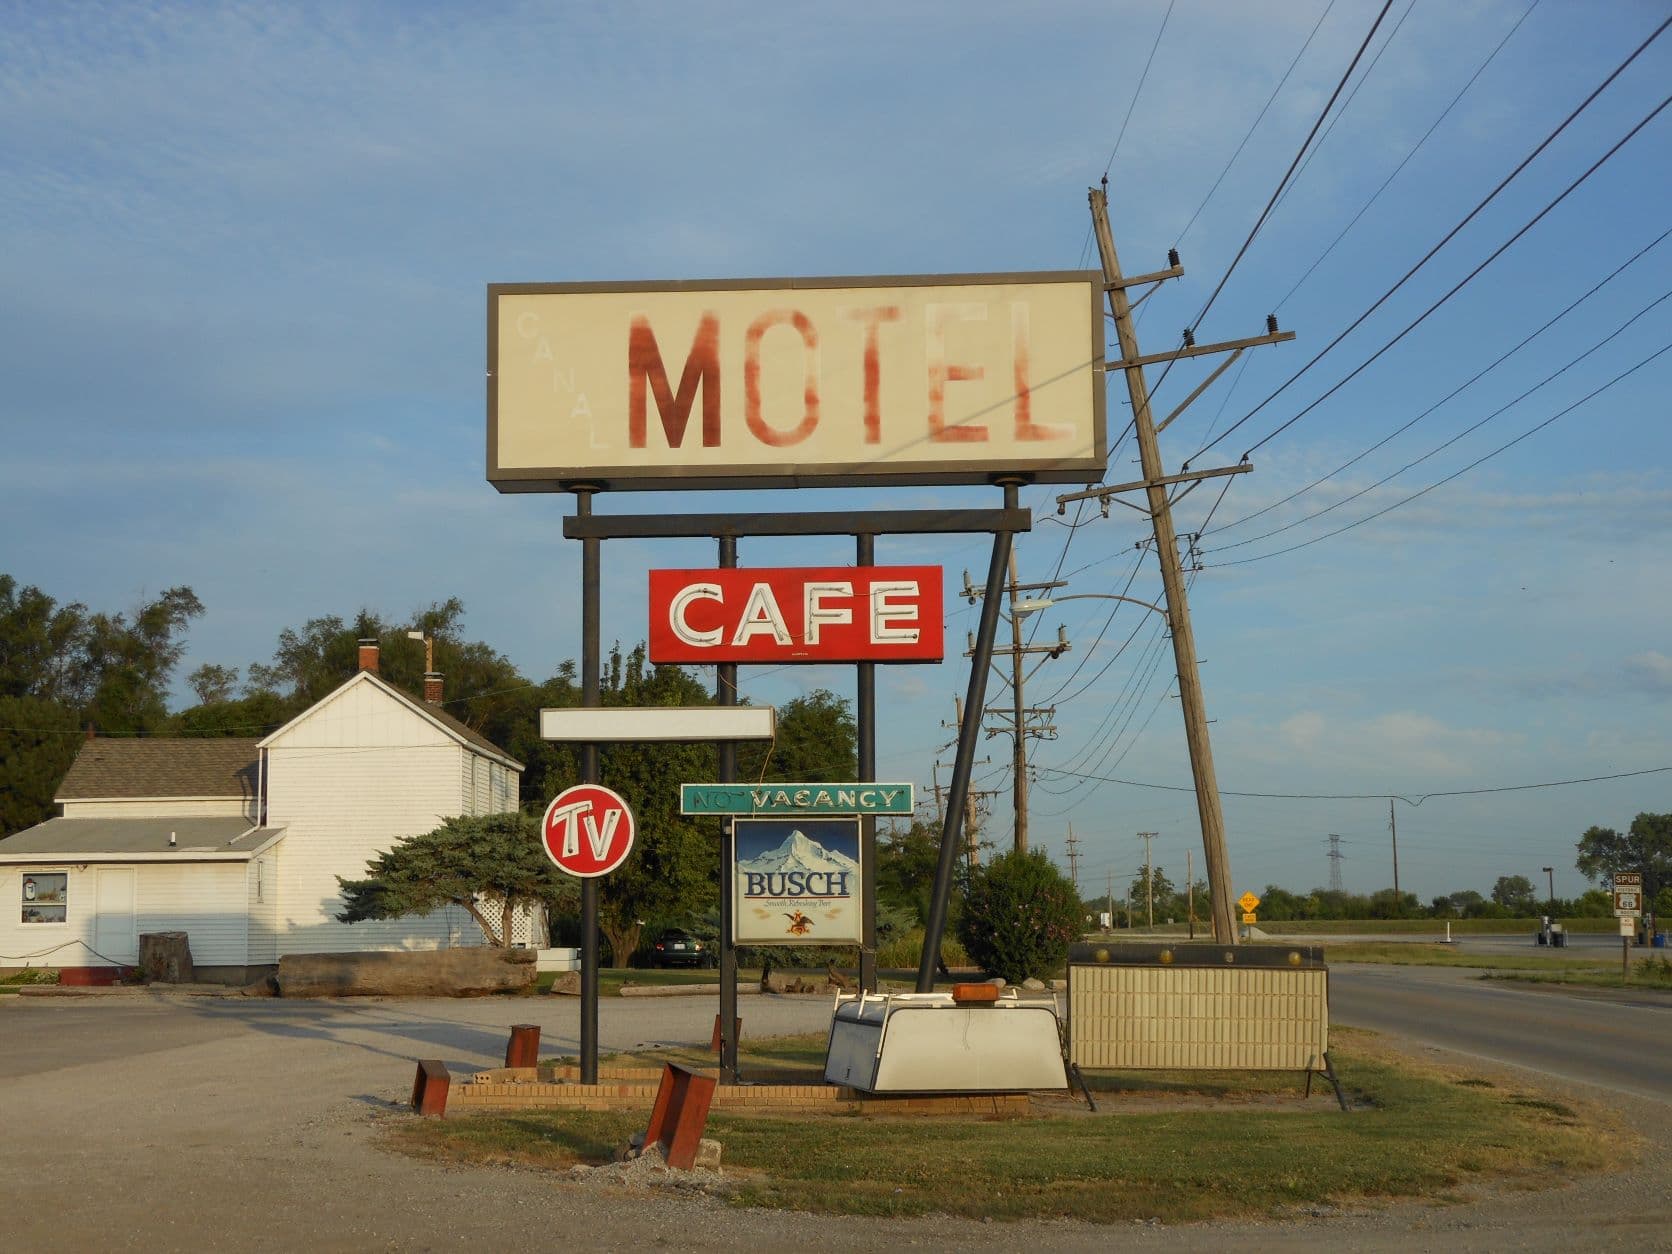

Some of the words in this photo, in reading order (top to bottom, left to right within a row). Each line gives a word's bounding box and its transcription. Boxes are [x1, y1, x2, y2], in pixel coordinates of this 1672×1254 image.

[515, 311, 611, 449] CANAL
[628, 302, 1077, 448] MOTEL
[669, 581, 920, 647] CAFE
[693, 791, 732, 809] NO
[751, 790, 898, 807] VACANCY
[552, 800, 622, 861] TV
[744, 871, 850, 896] BUSCH
[1616, 875, 1639, 884] SPUR
